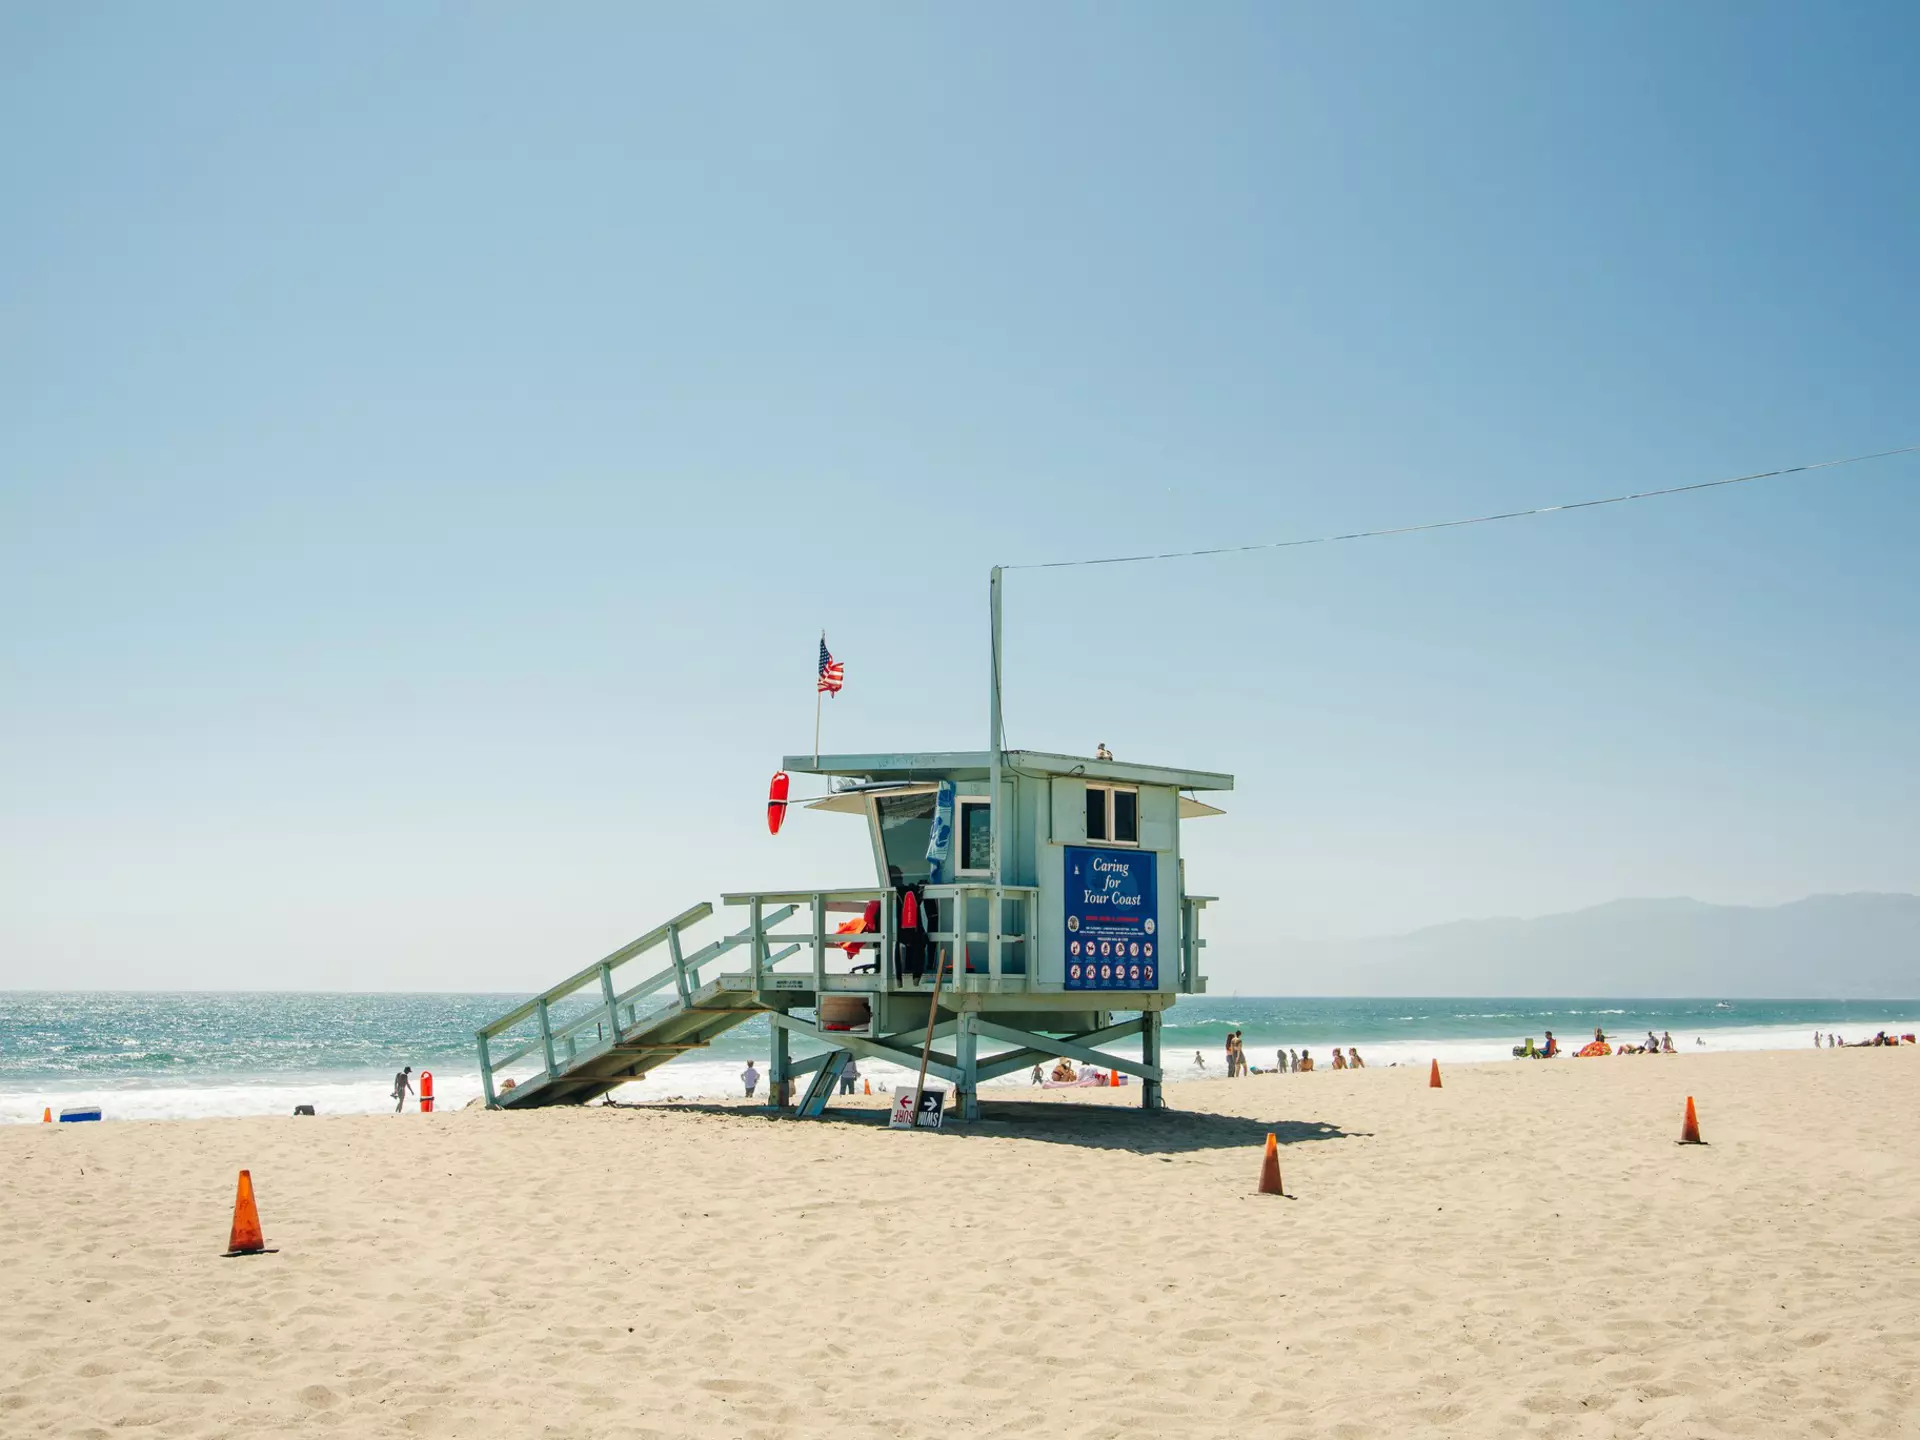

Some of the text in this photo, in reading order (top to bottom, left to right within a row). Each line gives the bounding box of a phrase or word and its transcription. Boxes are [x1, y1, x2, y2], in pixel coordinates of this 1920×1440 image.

[1093, 857, 1129, 876] Caring
[1103, 874, 1121, 891] for
[1084, 890, 1141, 906] Your Coast
[893, 1110, 914, 1123] SURF
[917, 1111, 939, 1127] SWIM
